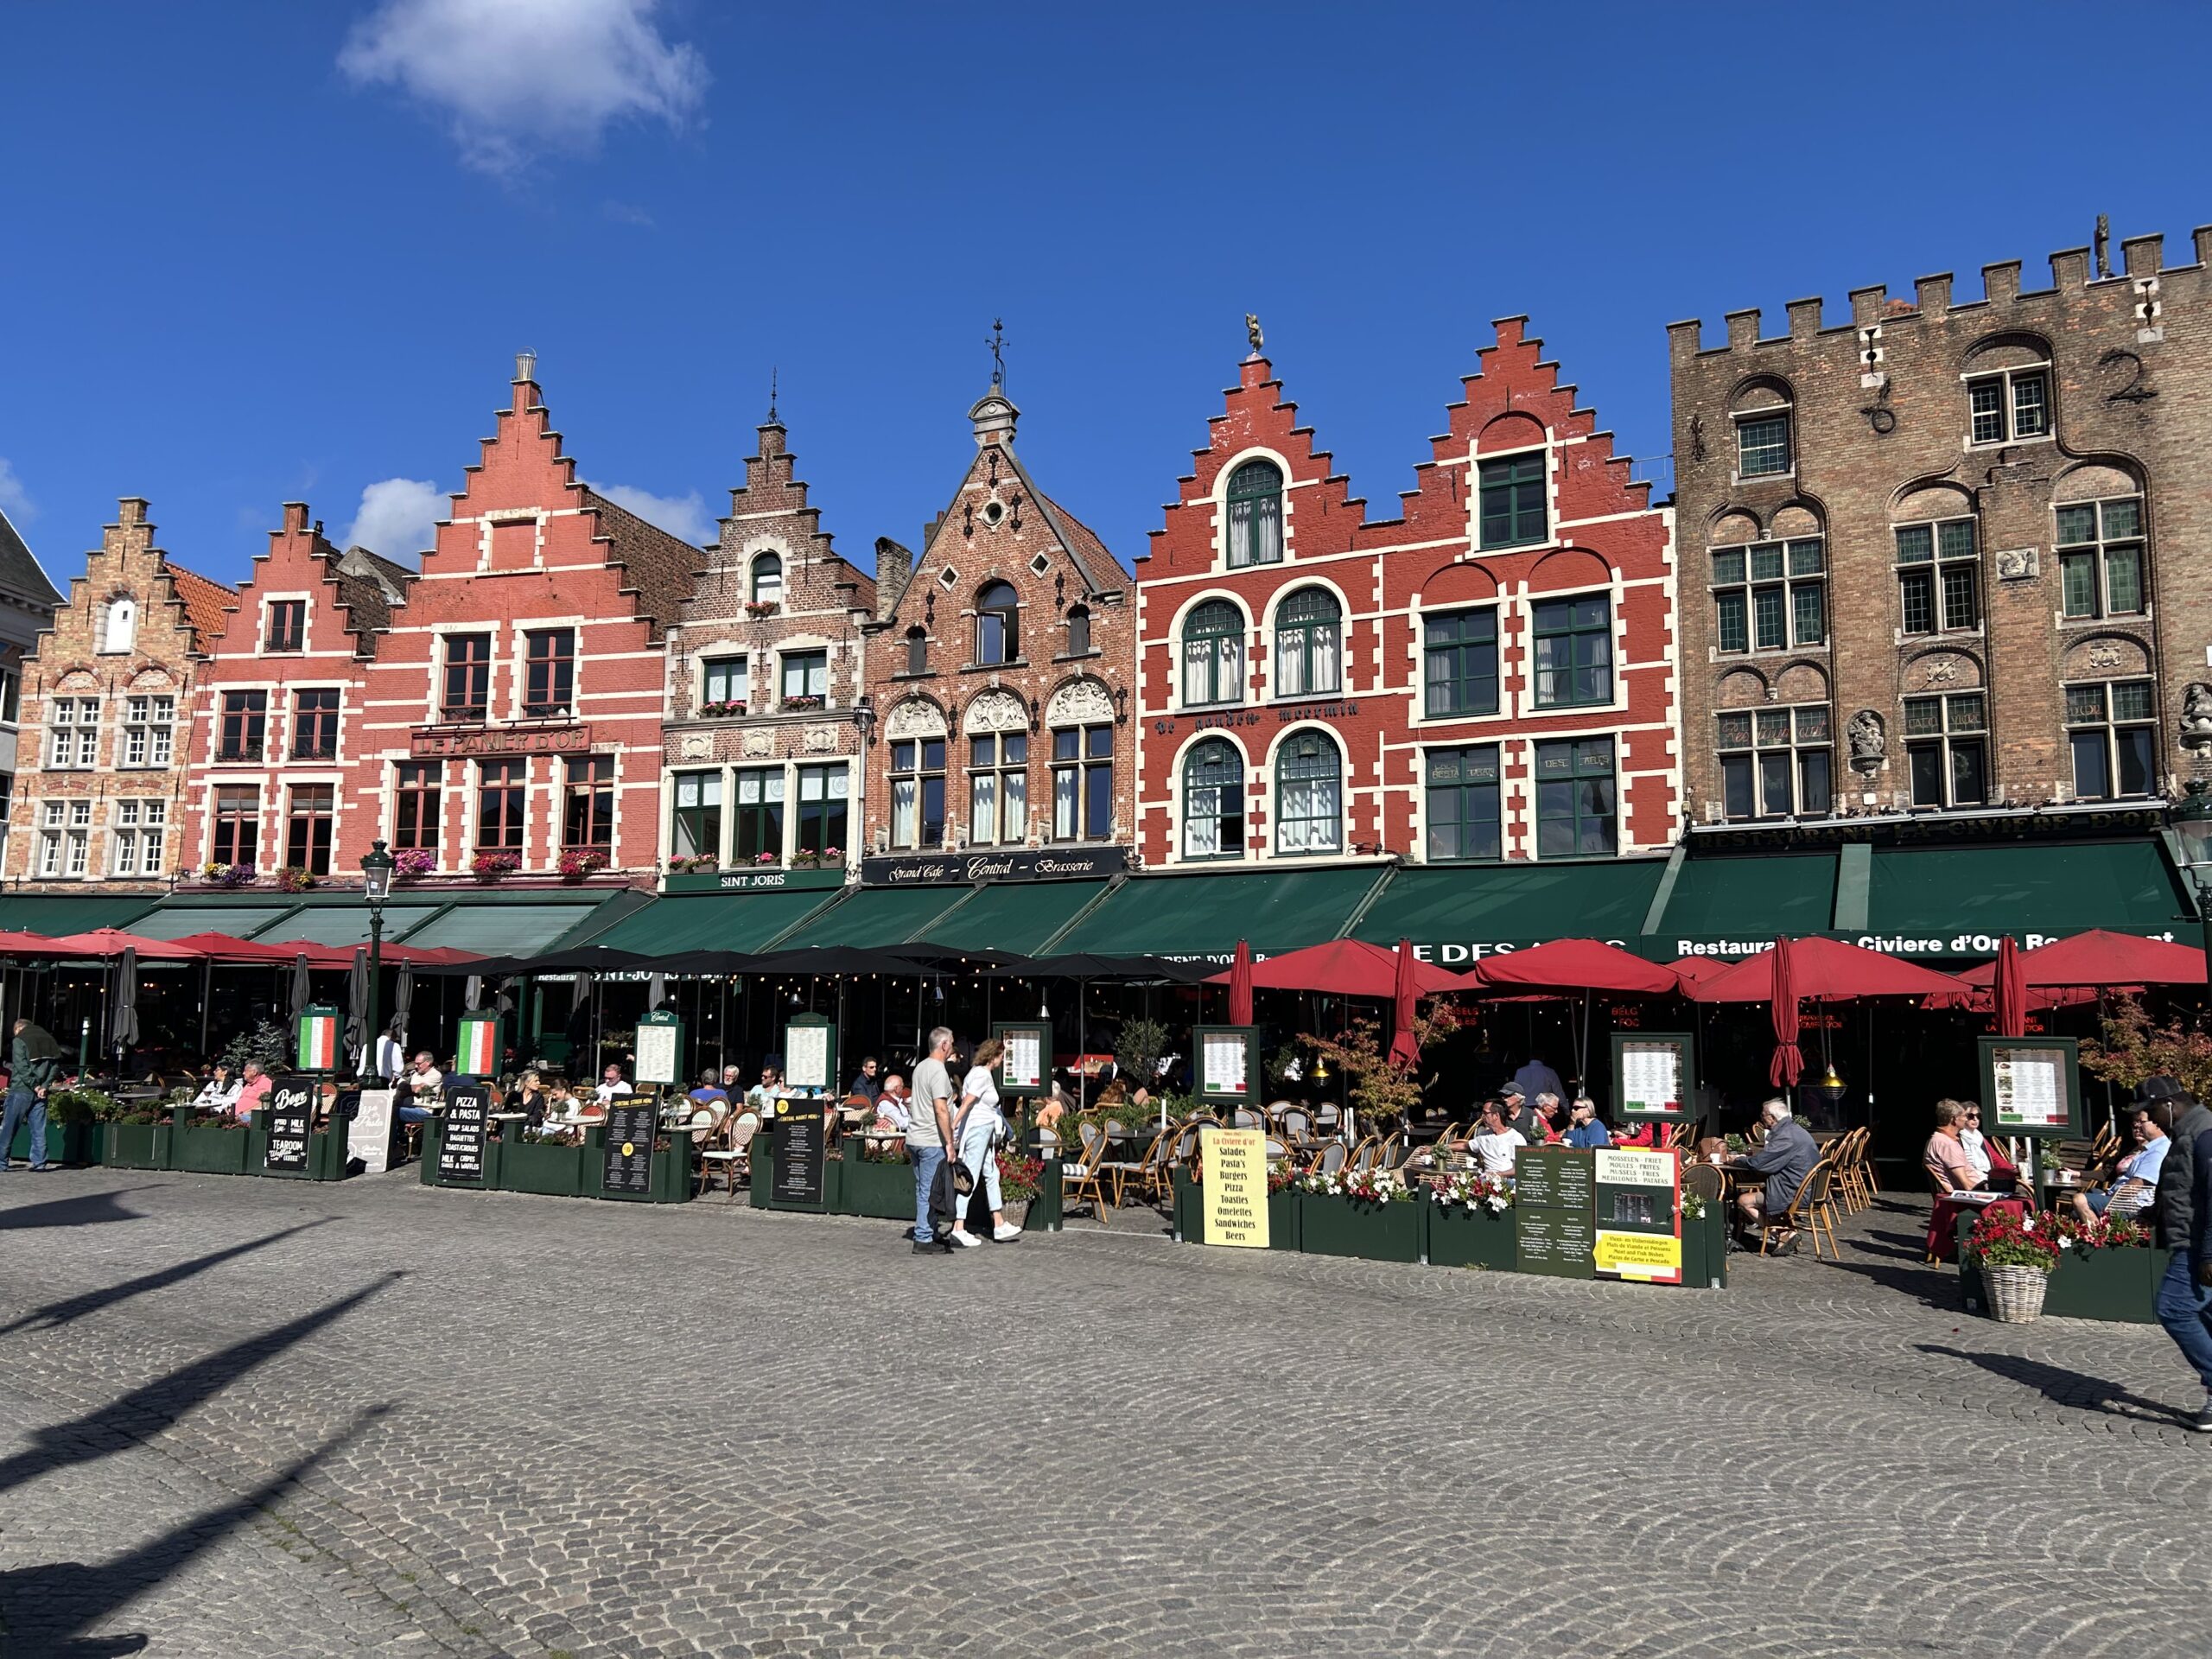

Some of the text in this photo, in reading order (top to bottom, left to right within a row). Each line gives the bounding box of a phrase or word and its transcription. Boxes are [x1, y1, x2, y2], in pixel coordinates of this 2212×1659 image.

[418, 730, 586, 753] LE PANIER D'OR
[1698, 810, 2163, 848] RESTAURANT LA CIVIERE D'OR
[889, 866, 921, 882] Grand
[966, 857, 1014, 880] Central
[1034, 860, 1094, 874] Brasserie
[721, 874, 785, 887] SINT JORIS
[1858, 936, 1942, 952] Civiere
[275, 1089, 308, 1110] Beer
[456, 1096, 477, 1108] PIZZA
[449, 1109, 480, 1120] & PASTA
[449, 1134, 475, 1142] BAGUETTES
[272, 1140, 303, 1151] TEAROOM
[1219, 1147, 1246, 1156] Salades
[441, 1154, 454, 1163] MILK
[1221, 1160, 1246, 1168] Pasta's
[1219, 1171, 1248, 1181] Burgers
[1224, 1183, 1243, 1192] Pizza
[1221, 1194, 1249, 1205] Toasties
[1217, 1207, 1252, 1217] Omelettes
[1215, 1218, 1255, 1229] Sandwiches
[1225, 1231, 1246, 1241] Beers
